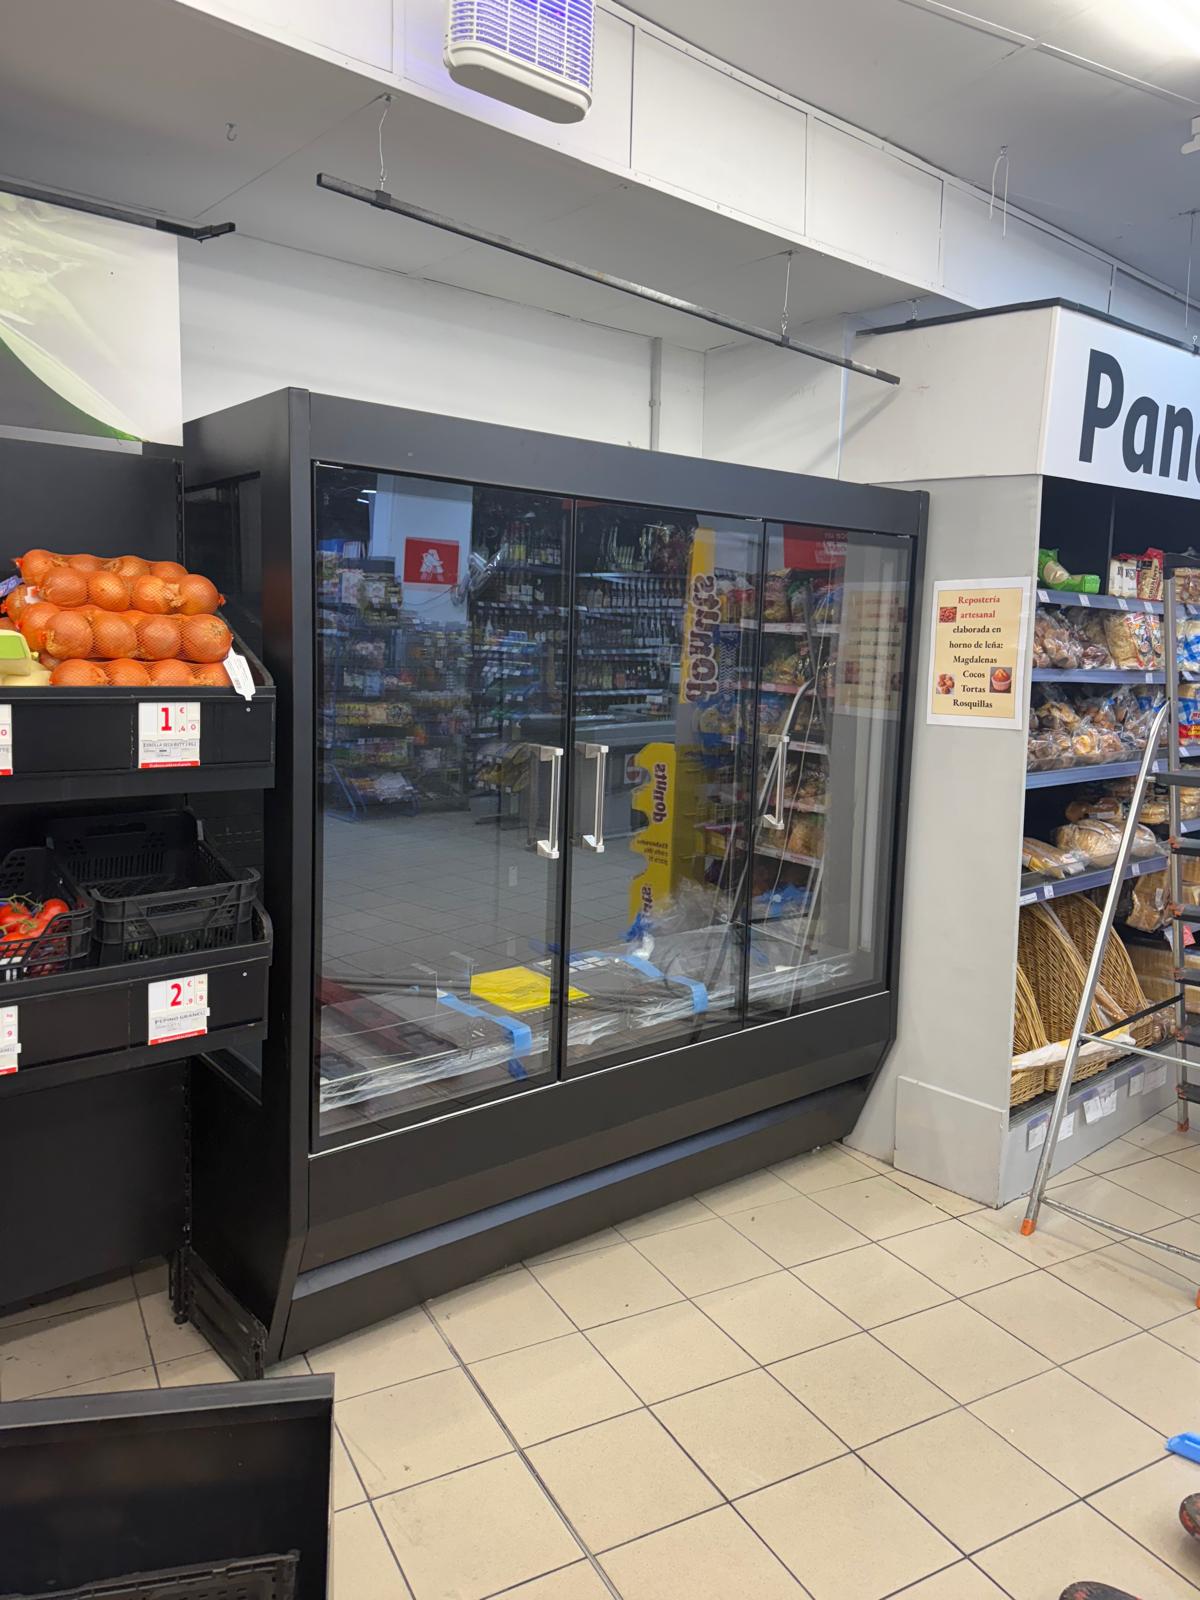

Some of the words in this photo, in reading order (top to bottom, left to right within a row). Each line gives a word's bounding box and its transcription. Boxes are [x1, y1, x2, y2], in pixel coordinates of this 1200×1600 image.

[1078, 348, 1200, 484] Pan
[958, 596, 1000, 606] Repostería
[960, 610, 996, 619] artesanal
[949, 641, 972, 649] horno
[974, 641, 983, 649] de
[985, 641, 1004, 649] leña:
[953, 656, 997, 666] Magdalenas
[962, 670, 986, 679] Cocos
[961, 684, 986, 693] Tortas
[953, 699, 993, 710] Rosquillas
[161, 707, 172, 731] 1
[170, 983, 182, 1007] 2
